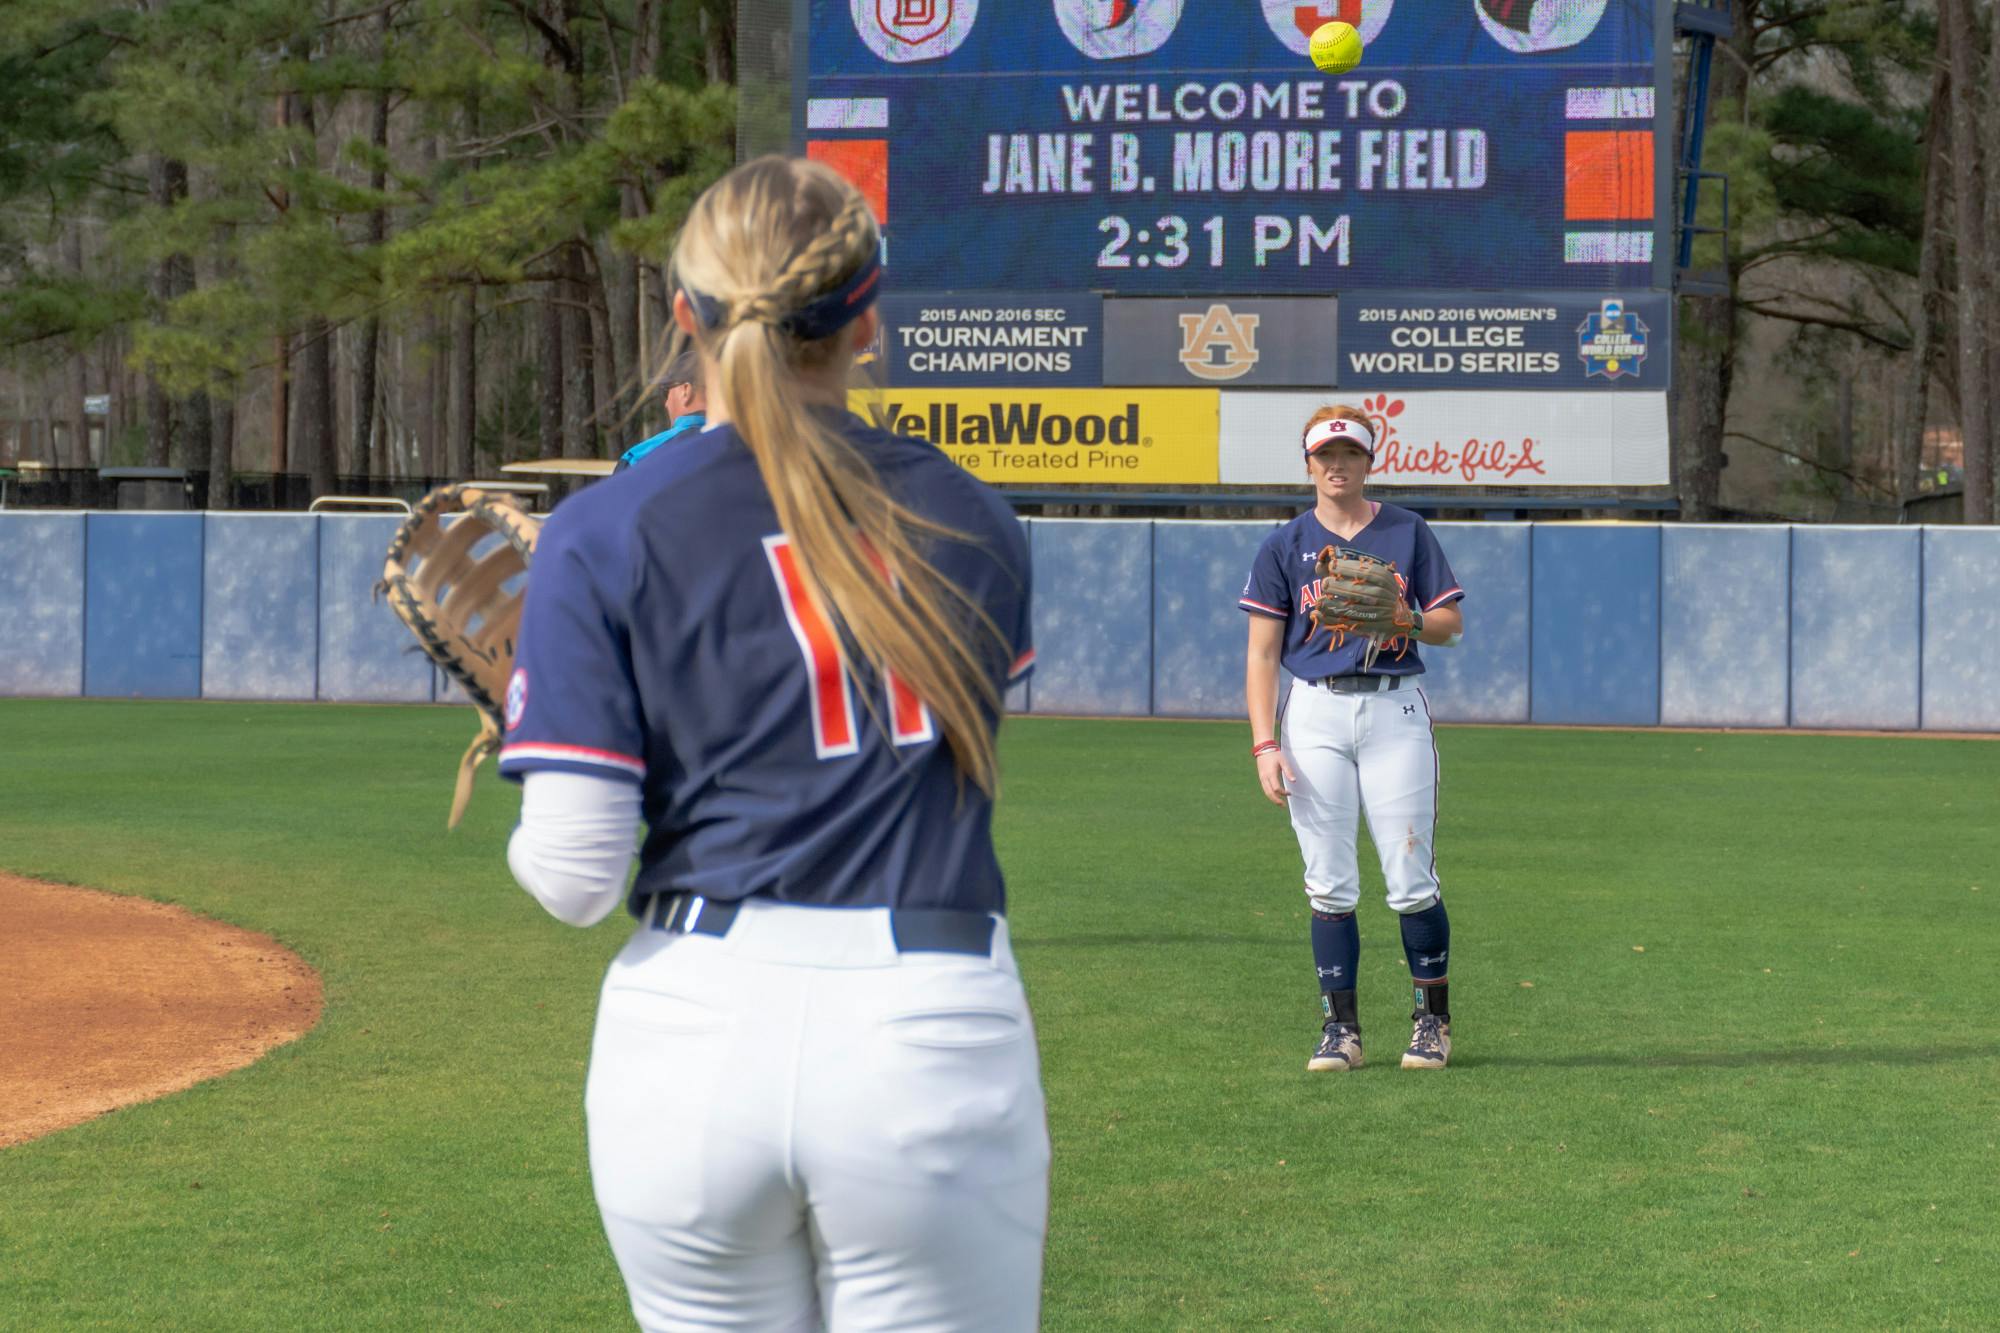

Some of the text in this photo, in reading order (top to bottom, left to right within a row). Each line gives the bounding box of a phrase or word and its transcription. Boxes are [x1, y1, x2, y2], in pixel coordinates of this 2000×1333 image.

[1062, 79, 1407, 121] WELCOME TO
[983, 129, 1488, 194] JANE B. MOORE FIELD
[1097, 214, 1351, 268] 2:31 PM
[920, 309, 1066, 322] 2015 AND 2016 SEC
[1359, 308, 1557, 322] 2015 AND 2016 WOMEN'S
[898, 326, 1088, 347] TOURNAMENT
[1391, 326, 1525, 347] COLLEGE
[908, 352, 1072, 372] CHAMPIONS
[1350, 352, 1560, 373] WORLD SERIES
[987, 450, 1079, 468] Treated
[1088, 450, 1139, 469] Pine
